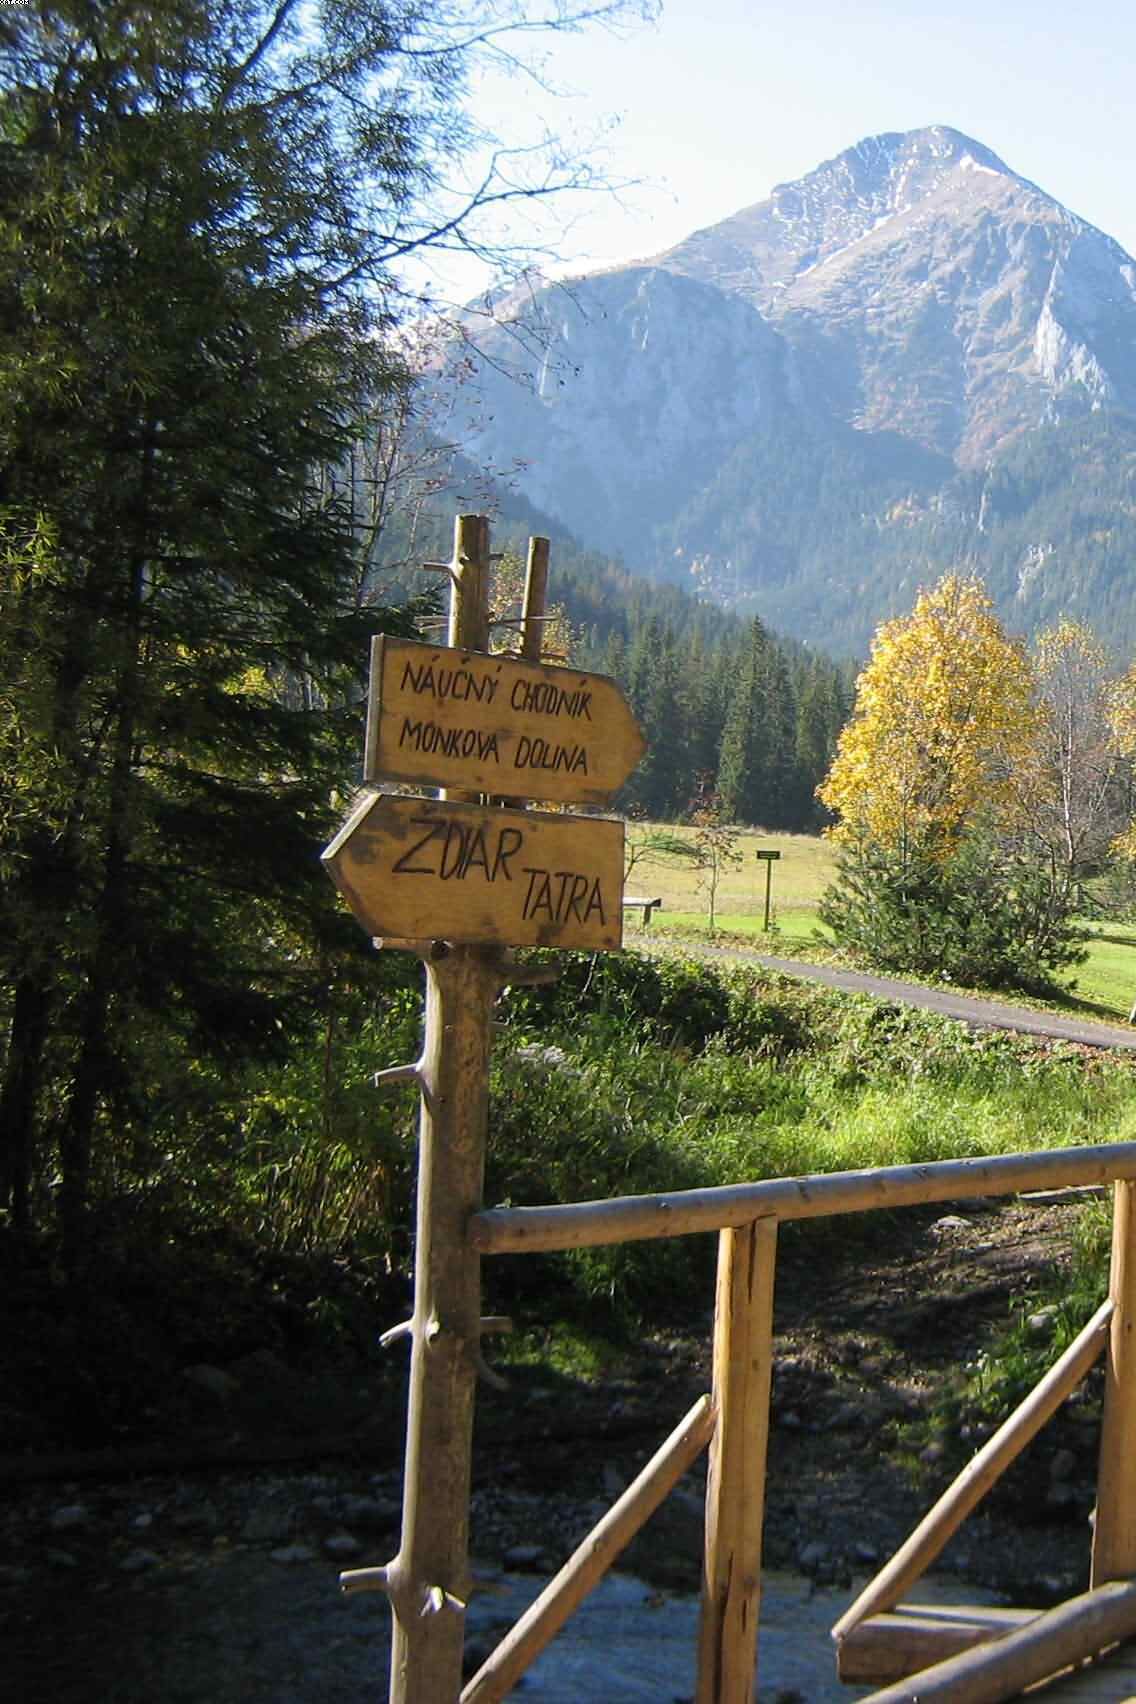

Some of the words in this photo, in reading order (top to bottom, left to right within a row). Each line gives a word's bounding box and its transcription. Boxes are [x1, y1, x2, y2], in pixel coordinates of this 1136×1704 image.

[510, 679, 593, 722] CHODNÍK
[399, 717, 499, 764] MONKOVA
[514, 735, 588, 776] DOLINA
[520, 868, 607, 926] TATRA
